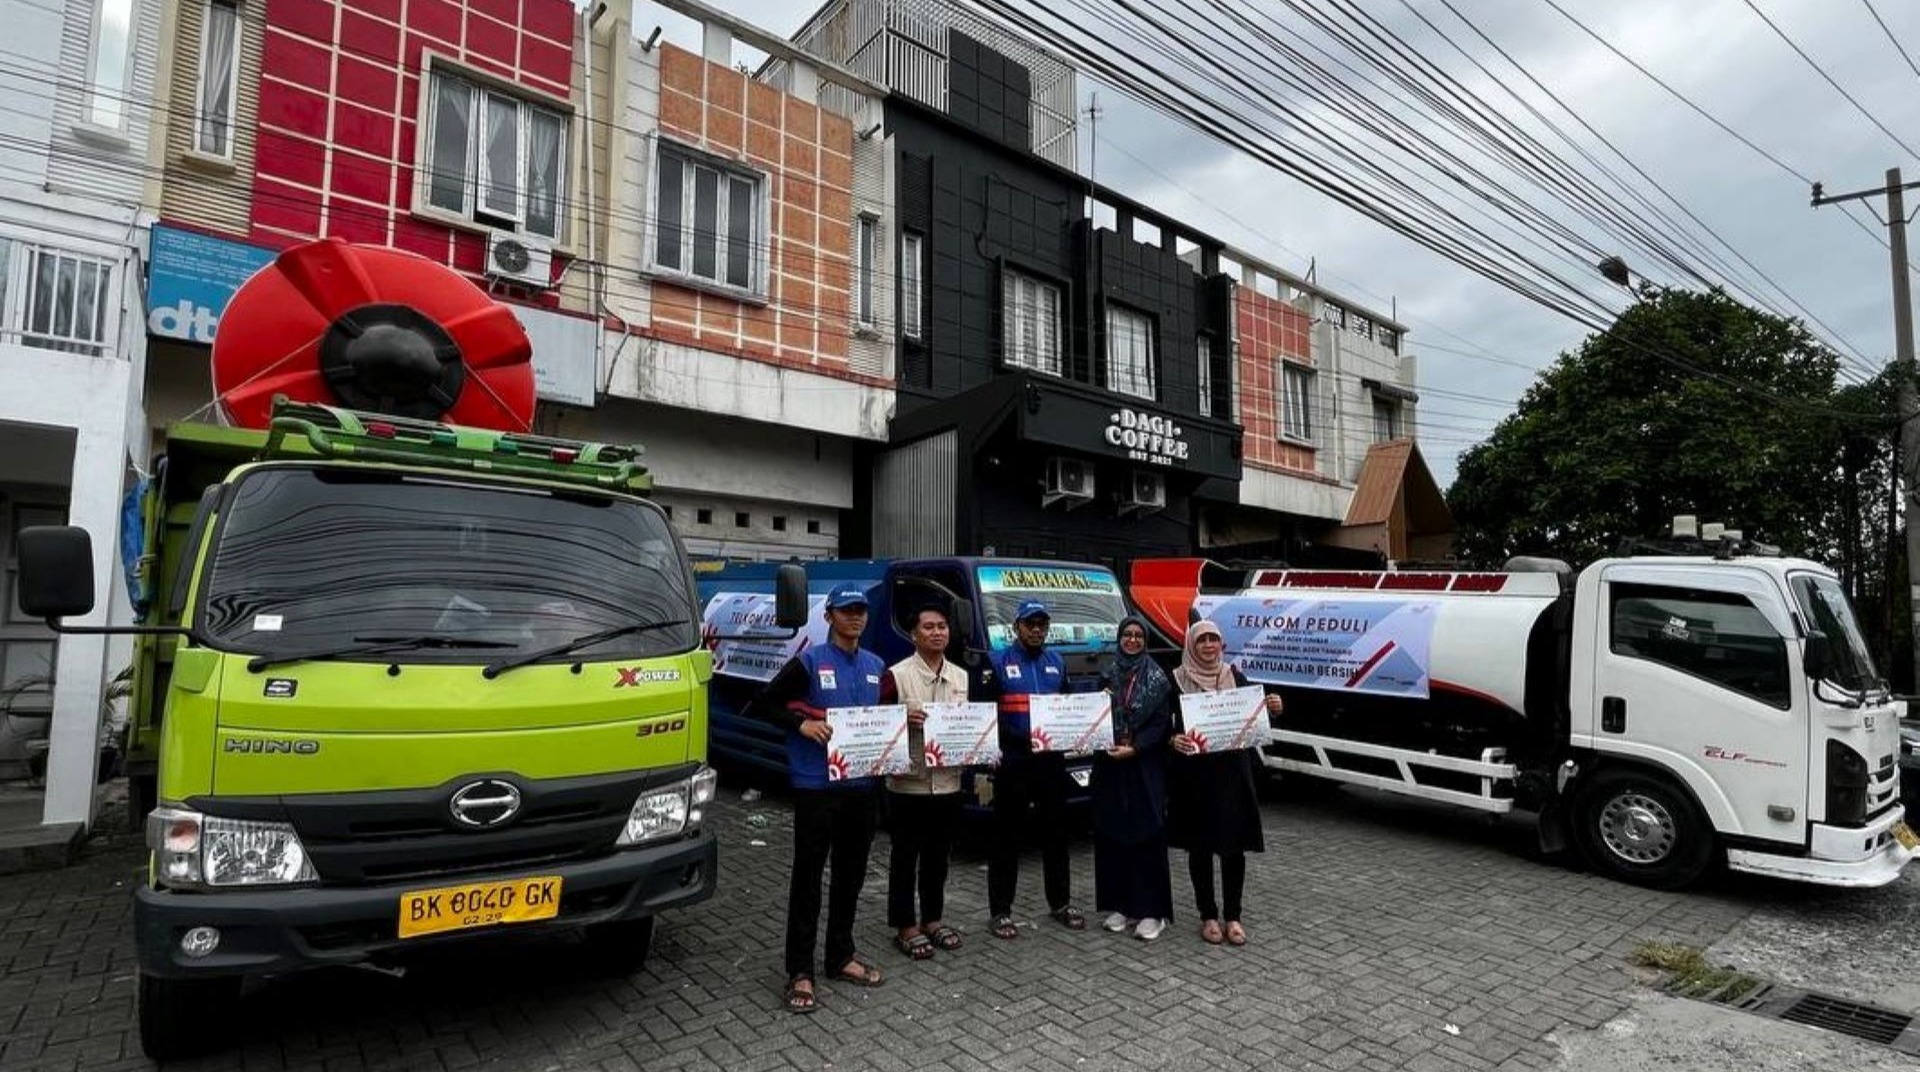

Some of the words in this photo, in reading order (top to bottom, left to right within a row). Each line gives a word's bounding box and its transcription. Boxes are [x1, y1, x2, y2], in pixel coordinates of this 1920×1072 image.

[1120, 408, 1173, 438] DAGI
[1105, 425, 1188, 460] COFFEE
[1236, 614, 1300, 631] TELKOM
[1306, 616, 1369, 633] PEDULI
[1241, 659, 1293, 673] BANTUAN
[1295, 664, 1315, 676] AIR
[636, 719, 685, 737] 300
[224, 738, 320, 755] HINO
[1704, 745, 1748, 761] ELF
[411, 894, 442, 922] BK
[525, 882, 555, 906] GK
